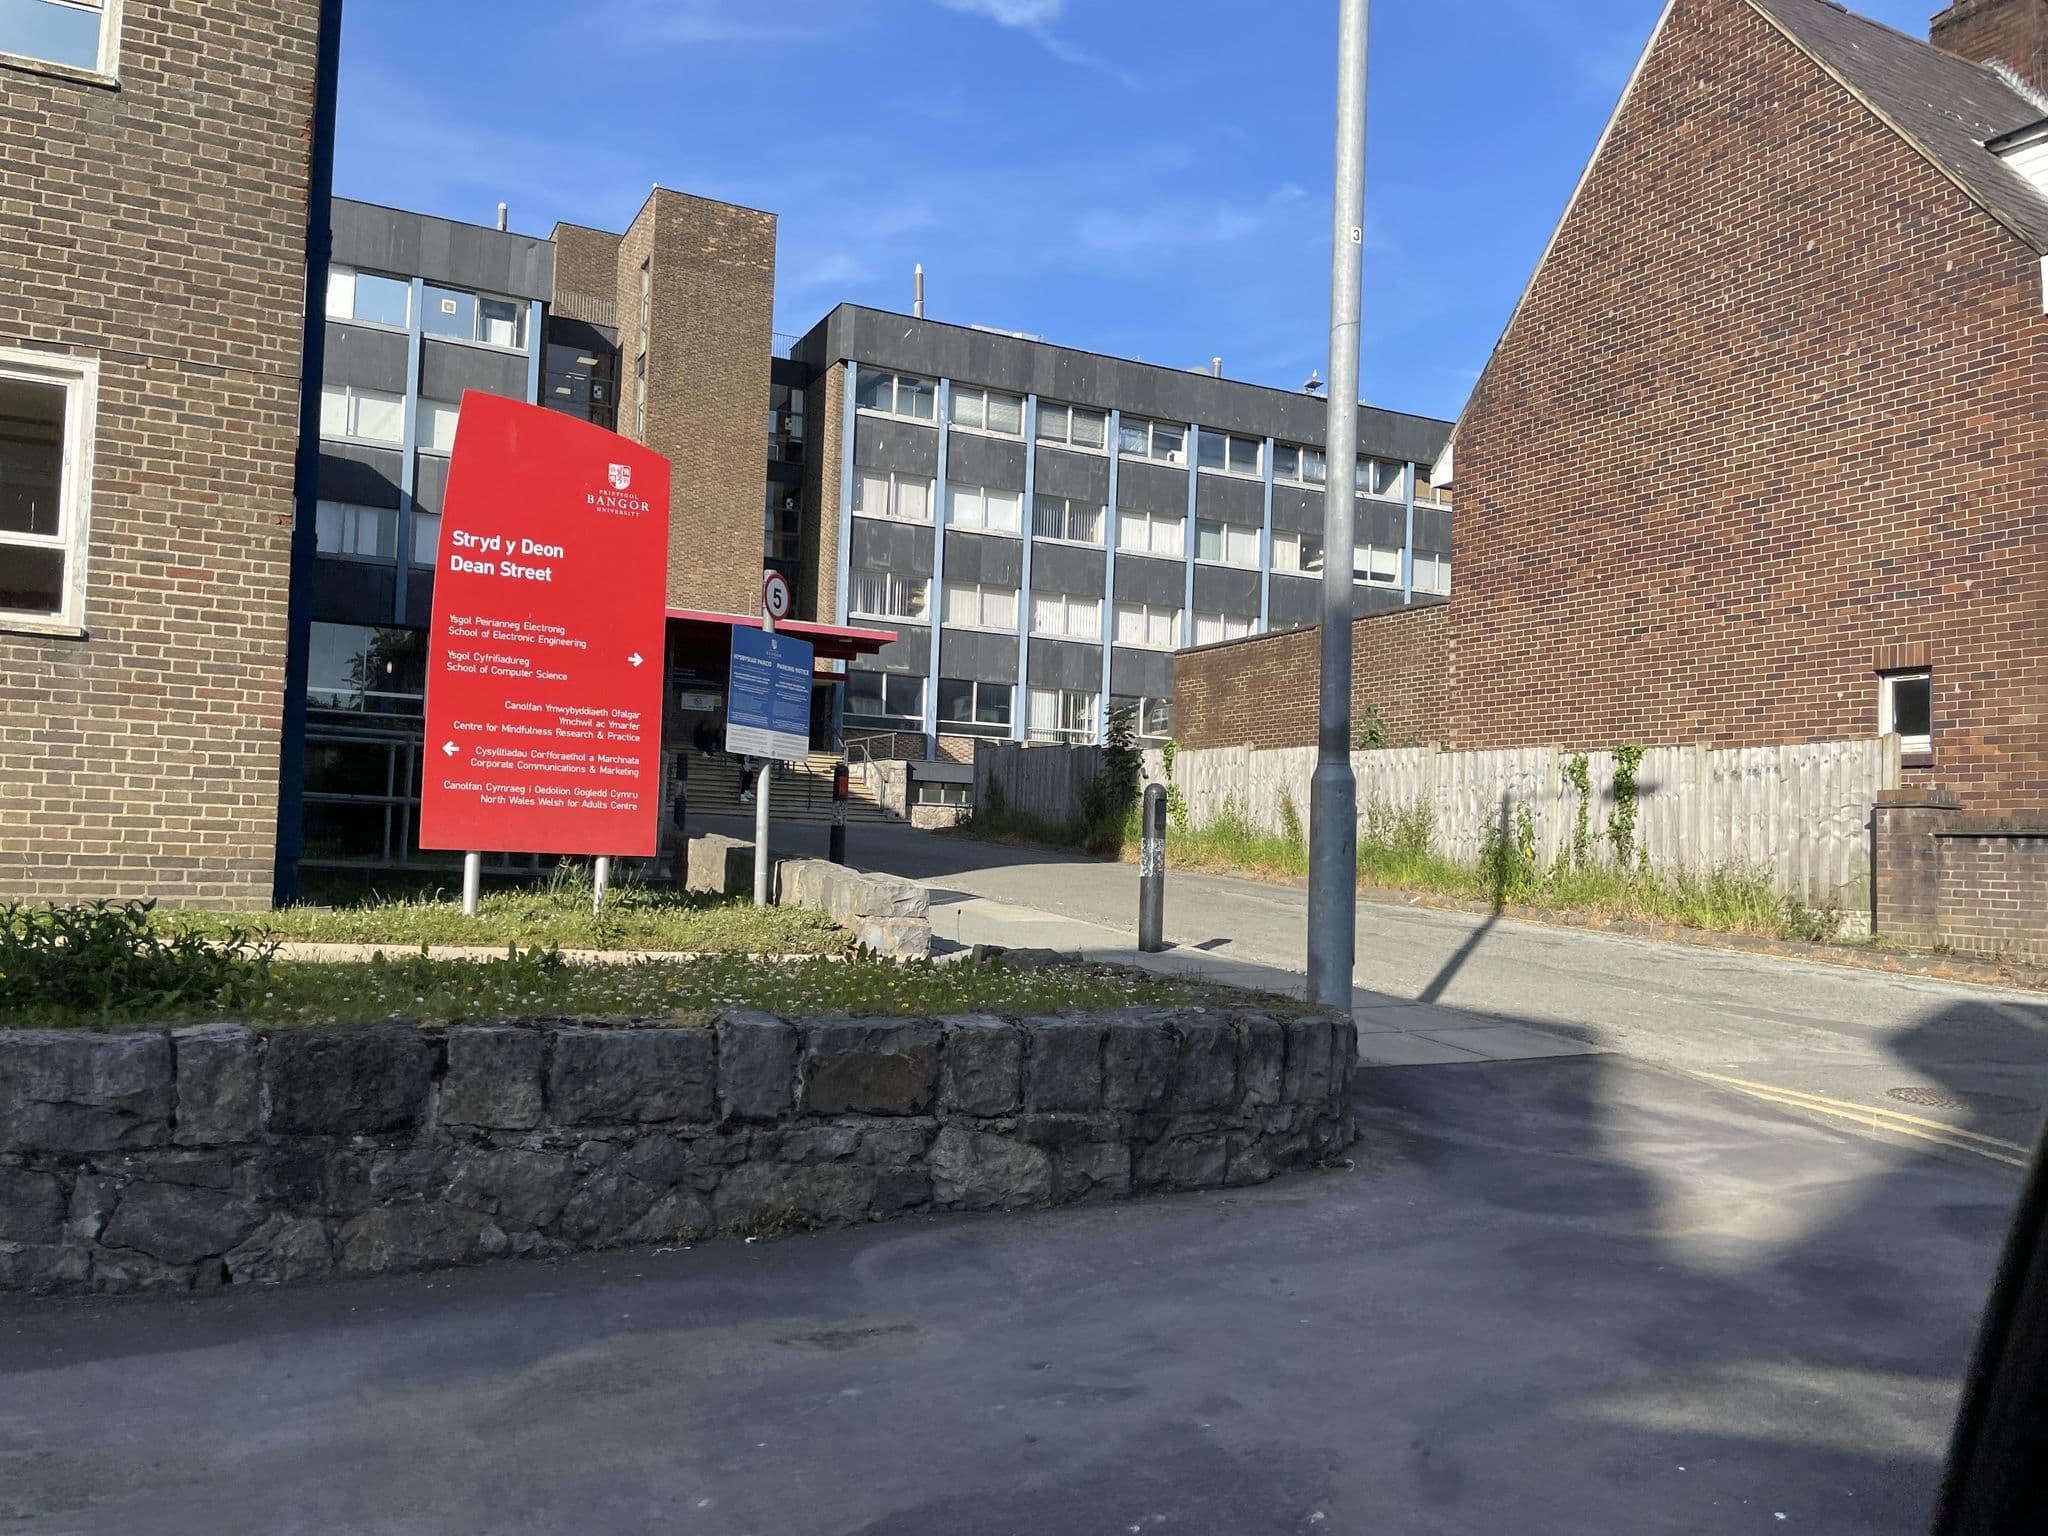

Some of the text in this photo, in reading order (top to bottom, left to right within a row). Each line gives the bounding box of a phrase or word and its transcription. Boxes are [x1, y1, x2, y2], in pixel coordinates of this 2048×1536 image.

[1353, 229, 1360, 241] 3
[587, 494, 650, 512] BANGOR
[596, 507, 640, 517] UNIVERSITY
[452, 530, 564, 558] Stryd y Deon
[450, 555, 552, 581] Dean Street
[773, 588, 782, 609] 5
[449, 614, 566, 636] Ysgol Peirianneg Electronig
[448, 626, 587, 649] School of Electronic Engineering
[447, 650, 530, 667] Ysgol Cyfrifiadureg
[446, 662, 568, 681] School of Computer Science
[504, 700, 641, 721] Canolfan Ymwybyddiaeth Ofalgar
[453, 720, 641, 742] Centre for Mindfulness Research & Practice
[558, 716, 641, 731] Ymchwil ac Ymarfer
[475, 746, 528, 758] Cysylltiadau
[530, 749, 586, 762] Corfforaethol
[597, 754, 640, 765] Marchnata
[470, 758, 640, 778] Corporate Communications & Marketing
[443, 780, 482, 791] Canolfan
[485, 783, 526, 795] Cymraeg
[534, 785, 571, 796] Oedolion
[573, 787, 608, 799] Gogledd
[610, 790, 639, 800] Cymru
[480, 794, 638, 811] North Wales Welsh for Adults Centre
